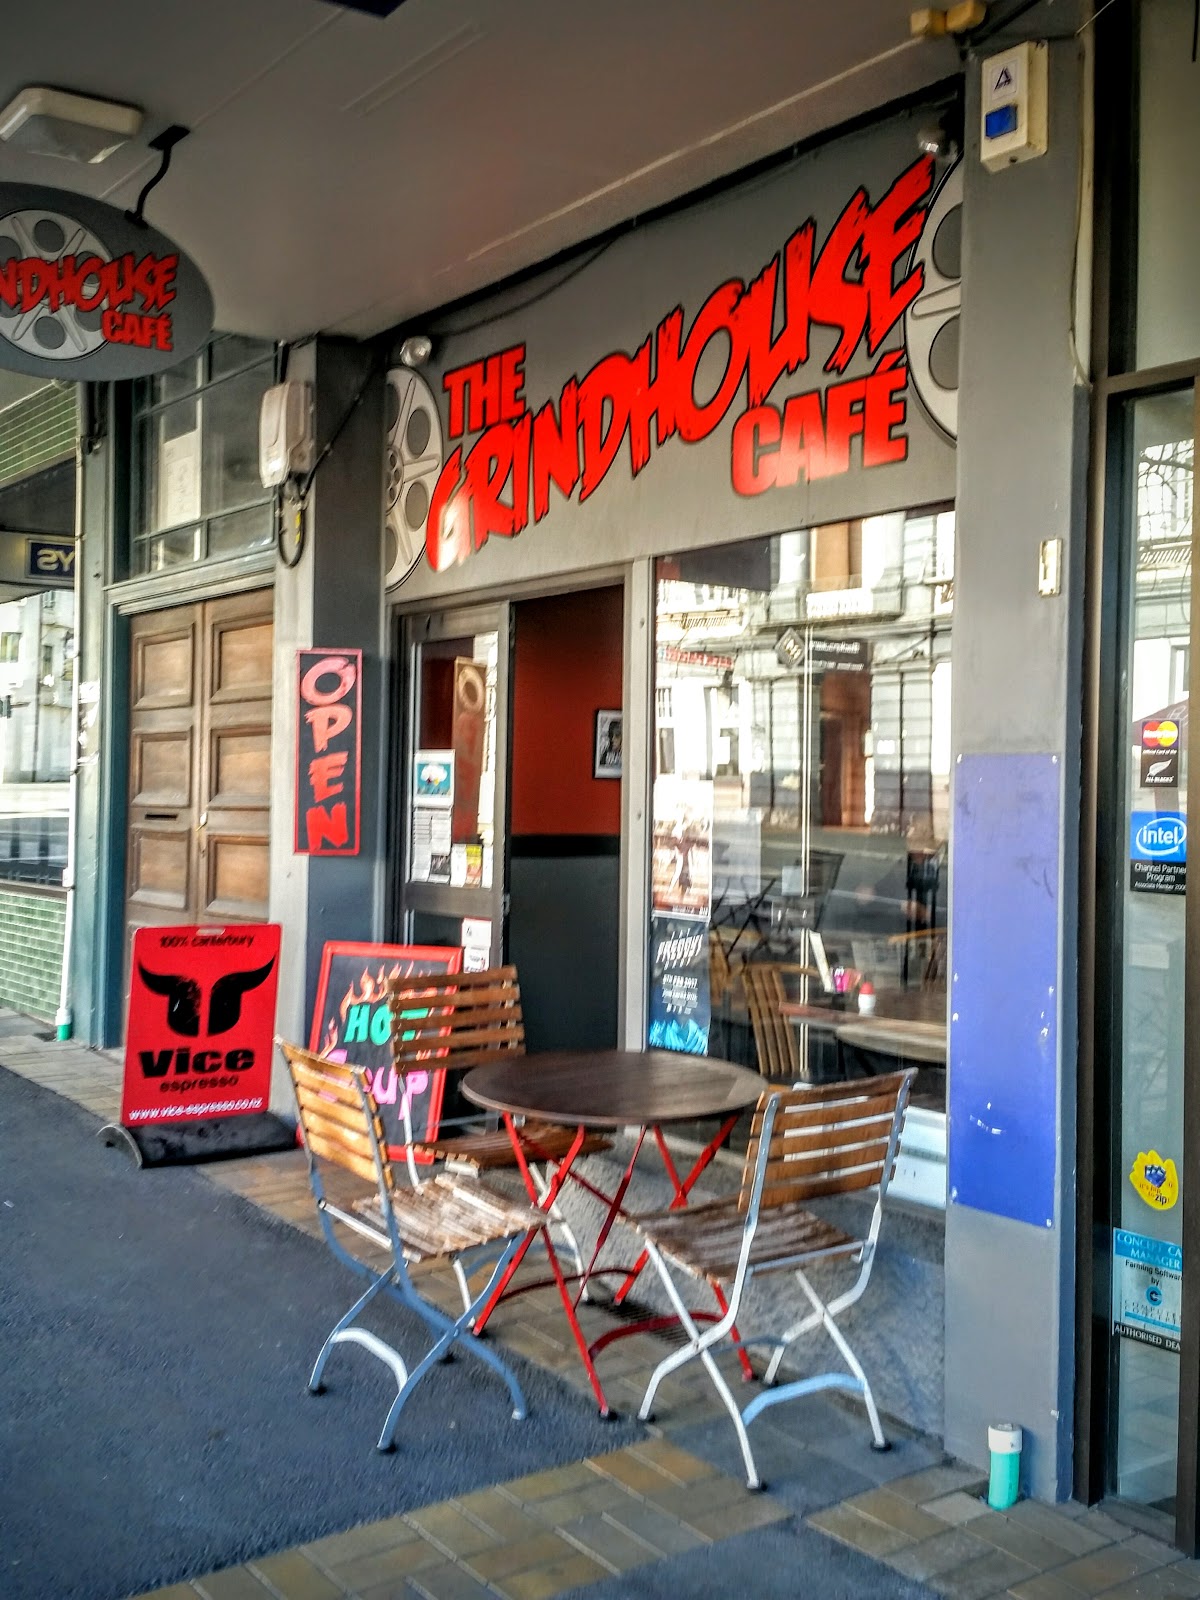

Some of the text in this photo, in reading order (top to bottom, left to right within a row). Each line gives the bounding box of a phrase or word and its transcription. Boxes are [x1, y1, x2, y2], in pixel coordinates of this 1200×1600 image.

[102, 310, 174, 351] CAFÉ
[427, 153, 937, 574] GRINDHOUSE
[443, 342, 527, 439] THE
[731, 349, 909, 498] CAFÉ
[300, 656, 357, 851] OPEN
[1142, 825, 1178, 845] intel
[1135, 863, 1161, 872] Channel
[1146, 872, 1175, 882] Program
[160, 934, 188, 948] 100%
[159, 1075, 239, 1094] espresso
[129, 1097, 263, 1121] www.vice-espresso.co.nz
[1116, 1231, 1162, 1250] CONCEPT
[1125, 1259, 1153, 1275] Farming
[1130, 1247, 1181, 1270] MANAGER
[1150, 1277, 1160, 1287] by
[1114, 1324, 1162, 1344] AUTHORISED
